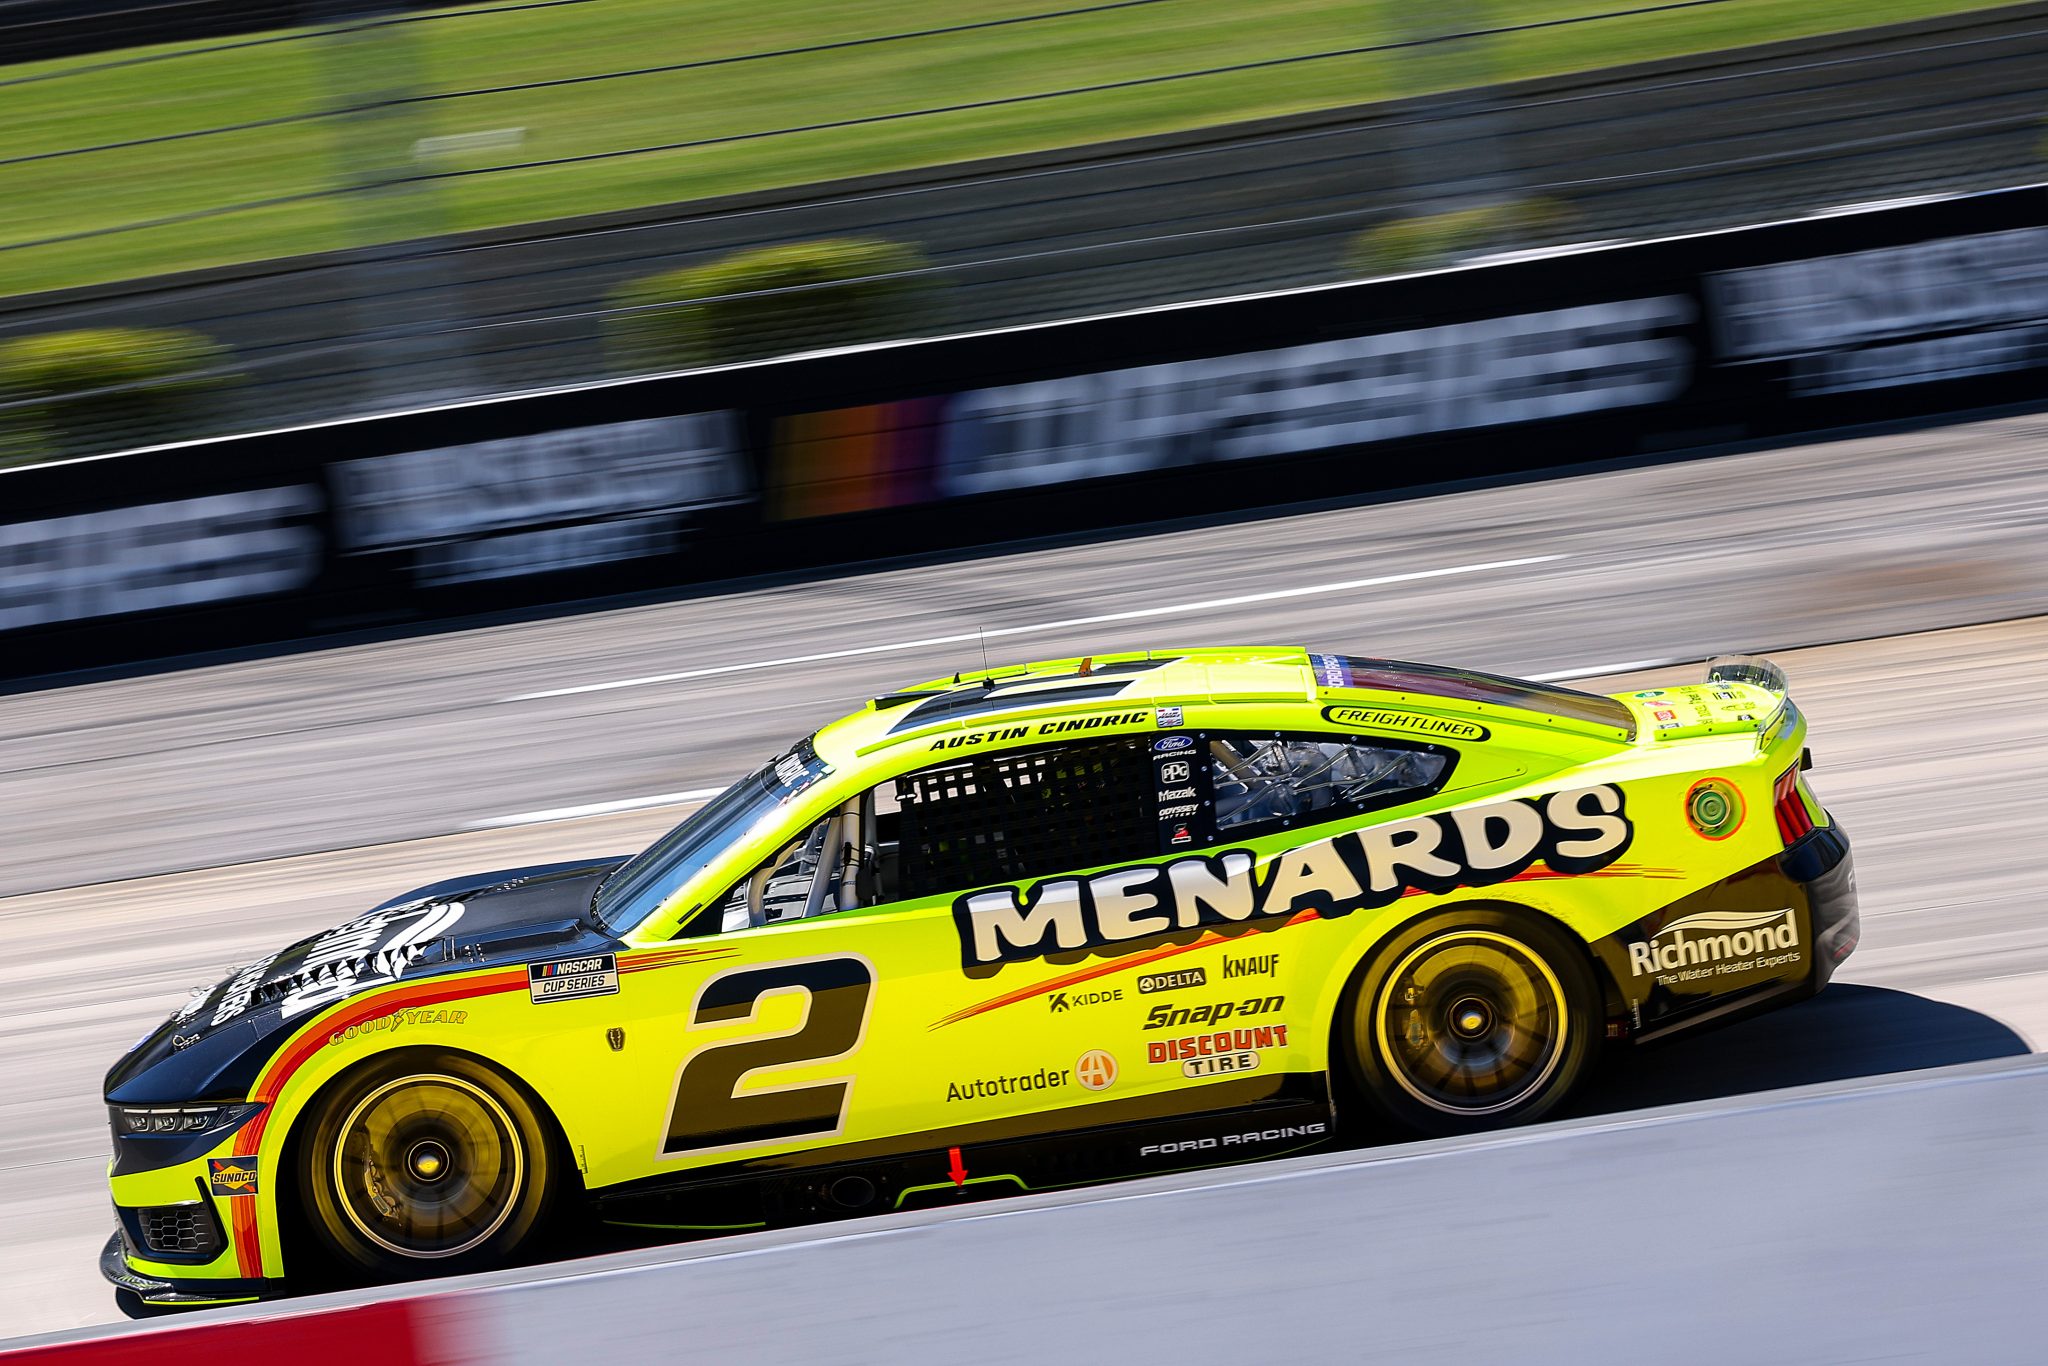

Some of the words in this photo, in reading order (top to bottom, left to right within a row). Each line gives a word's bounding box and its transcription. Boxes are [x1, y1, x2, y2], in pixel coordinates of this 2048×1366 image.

[929, 726, 1030, 752] AUSTIN
[1038, 711, 1149, 735] CINDRIC
[1336, 709, 1475, 736] FREIGHTLINER
[1160, 737, 1187, 750] Ford
[1163, 764, 1188, 781] PPG
[1158, 786, 1197, 803] Mazak
[1159, 803, 1199, 816] ODYSSEY
[966, 783, 1629, 963] MENARDS
[1628, 908, 1800, 977] Richmond
[556, 958, 603, 976] NASCAR
[1223, 954, 1280, 979] KNAUF
[1656, 973, 1678, 986] The
[1678, 967, 1714, 982] Water
[1715, 961, 1755, 976] Heater
[1756, 951, 1801, 969] Experts
[543, 980, 566, 993] CUP
[566, 975, 606, 990] SERIES
[1154, 970, 1206, 990] DELTA
[1071, 989, 1124, 1008] KIDDE
[1142, 995, 1286, 1031] Snap-on
[328, 1008, 468, 1046] GOODYEAR
[658, 954, 875, 1158] 2
[1147, 1024, 1288, 1064] DISCOUNT
[1190, 1055, 1252, 1075] TIRE
[946, 1068, 1070, 1103] Autotrader
[1140, 1138, 1217, 1157] FORD
[1222, 1122, 1326, 1146] RACING
[213, 1171, 257, 1183] SUNOCO
